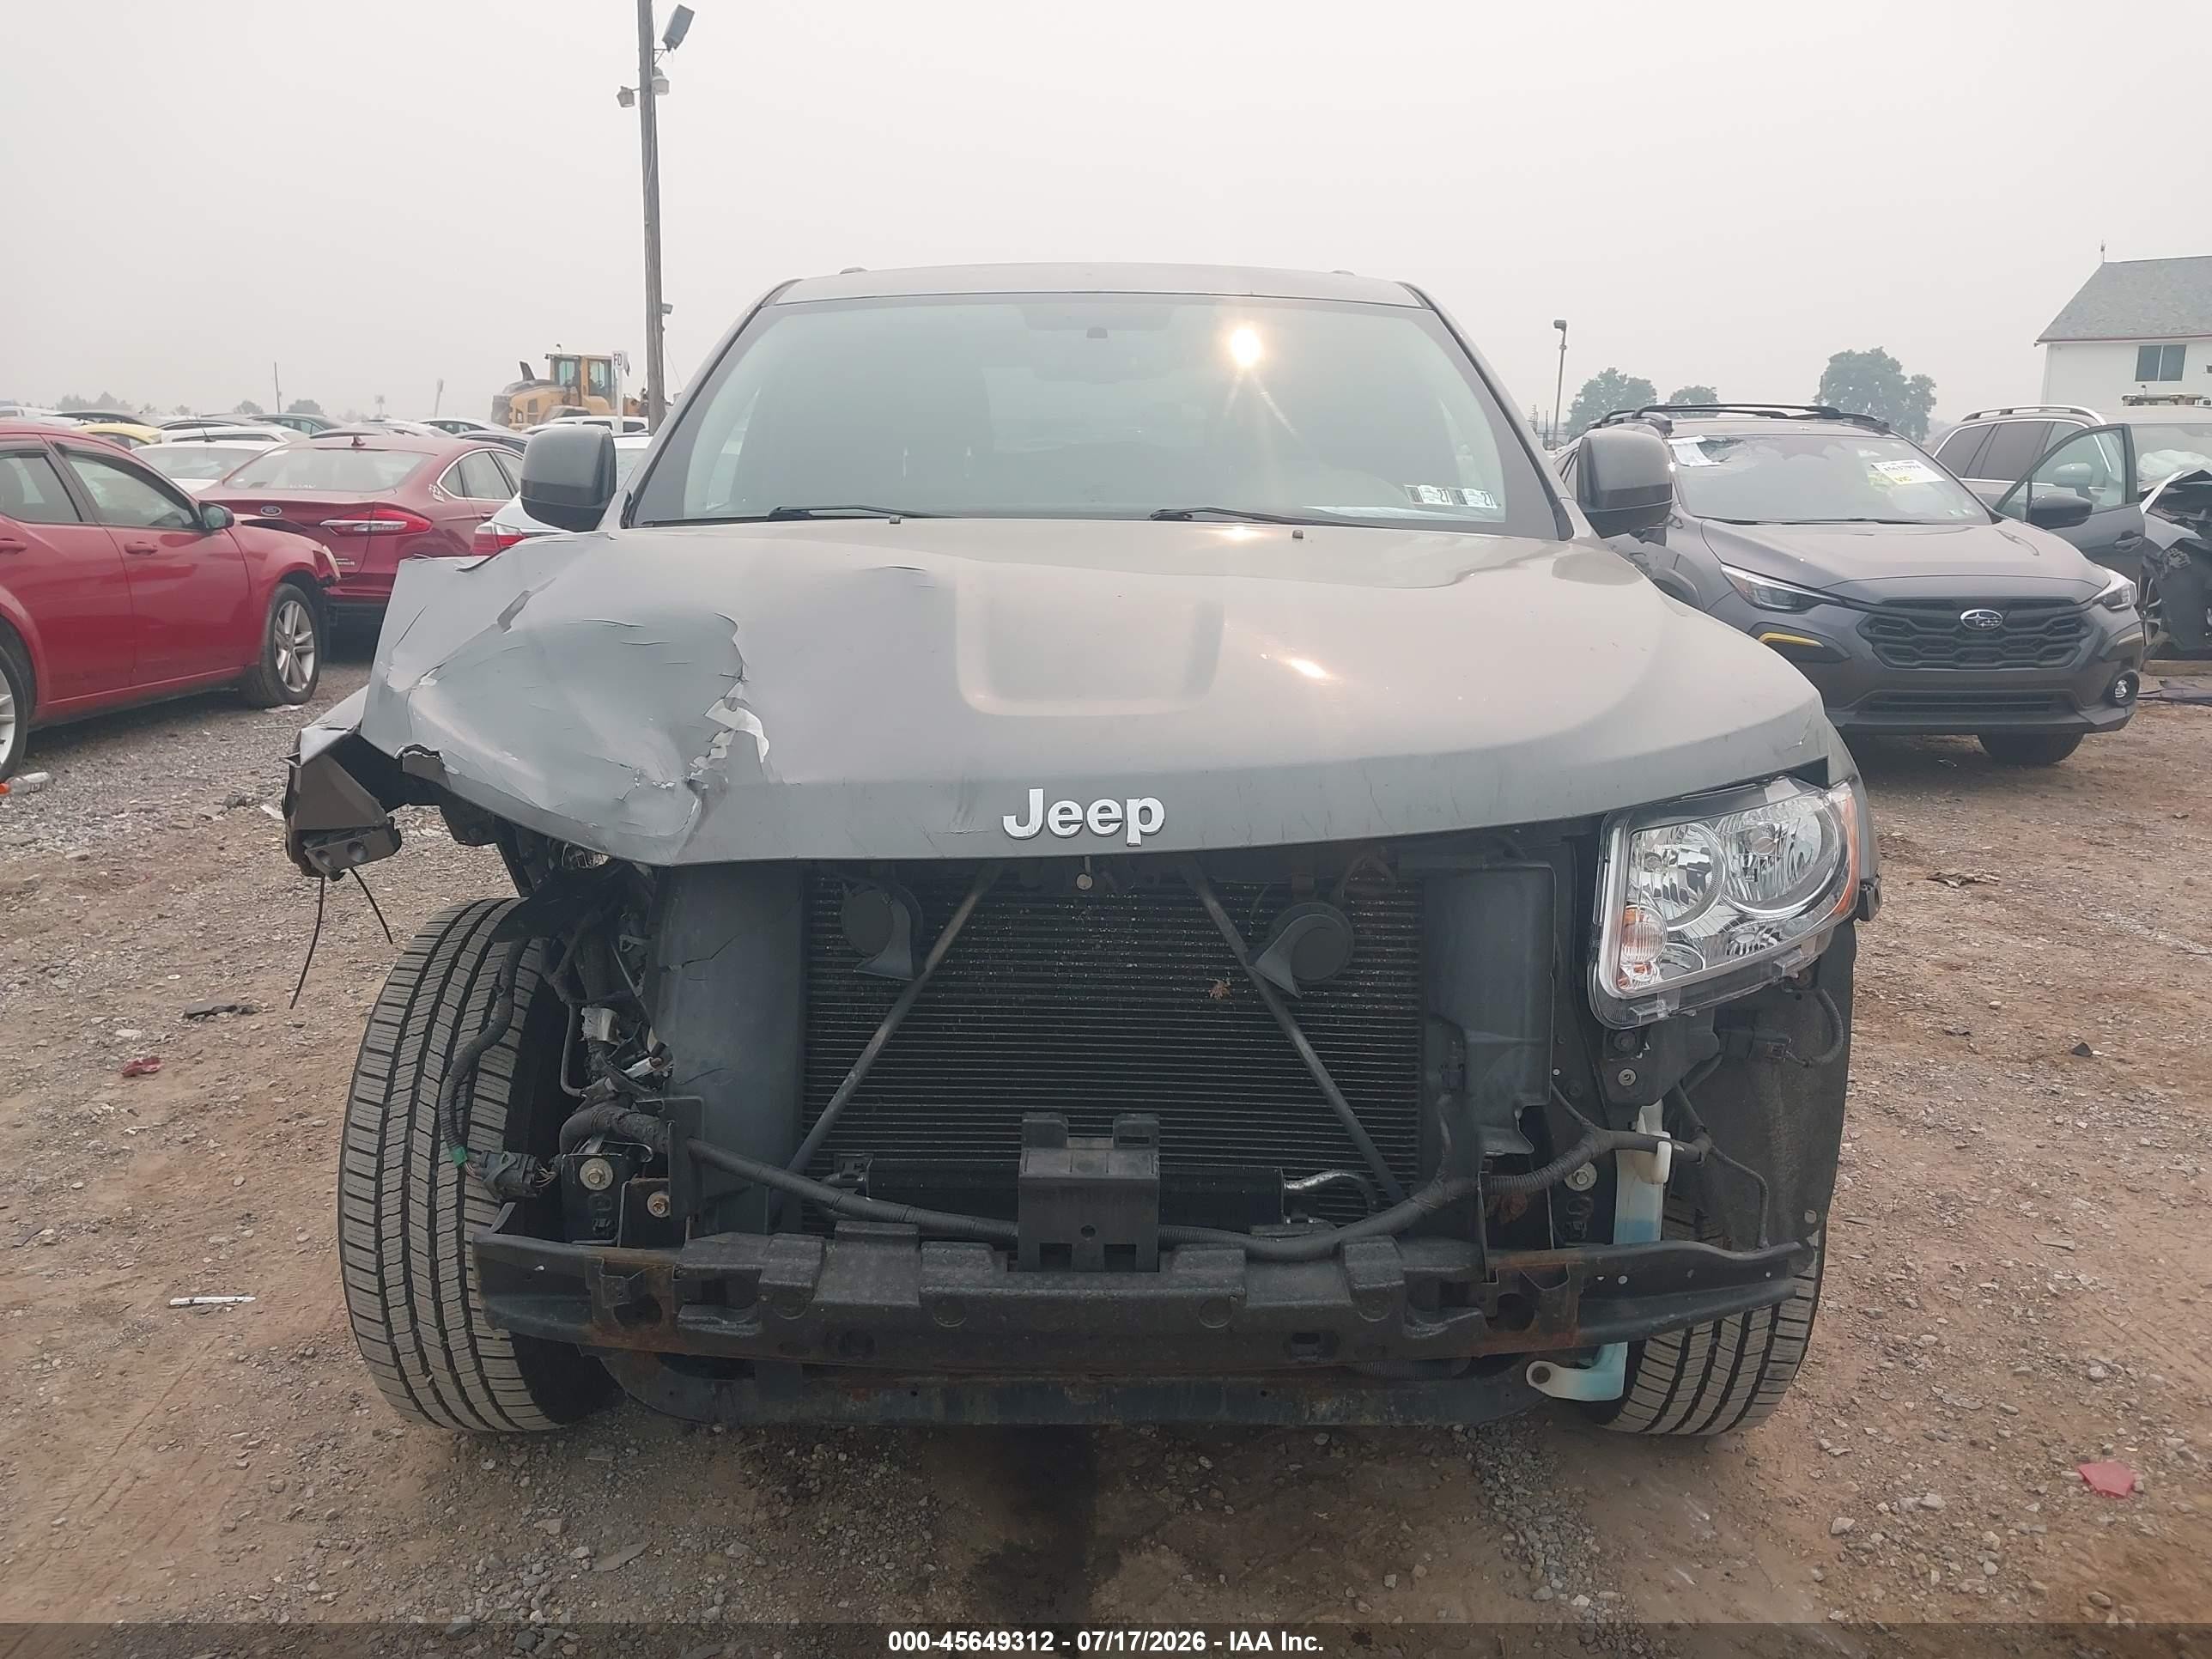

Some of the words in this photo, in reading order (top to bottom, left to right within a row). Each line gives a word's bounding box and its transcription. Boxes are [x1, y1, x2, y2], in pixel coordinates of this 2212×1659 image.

[1437, 489, 1449, 502] 27
[1480, 492, 1493, 506] 27
[1002, 787, 1165, 847] Jeep
